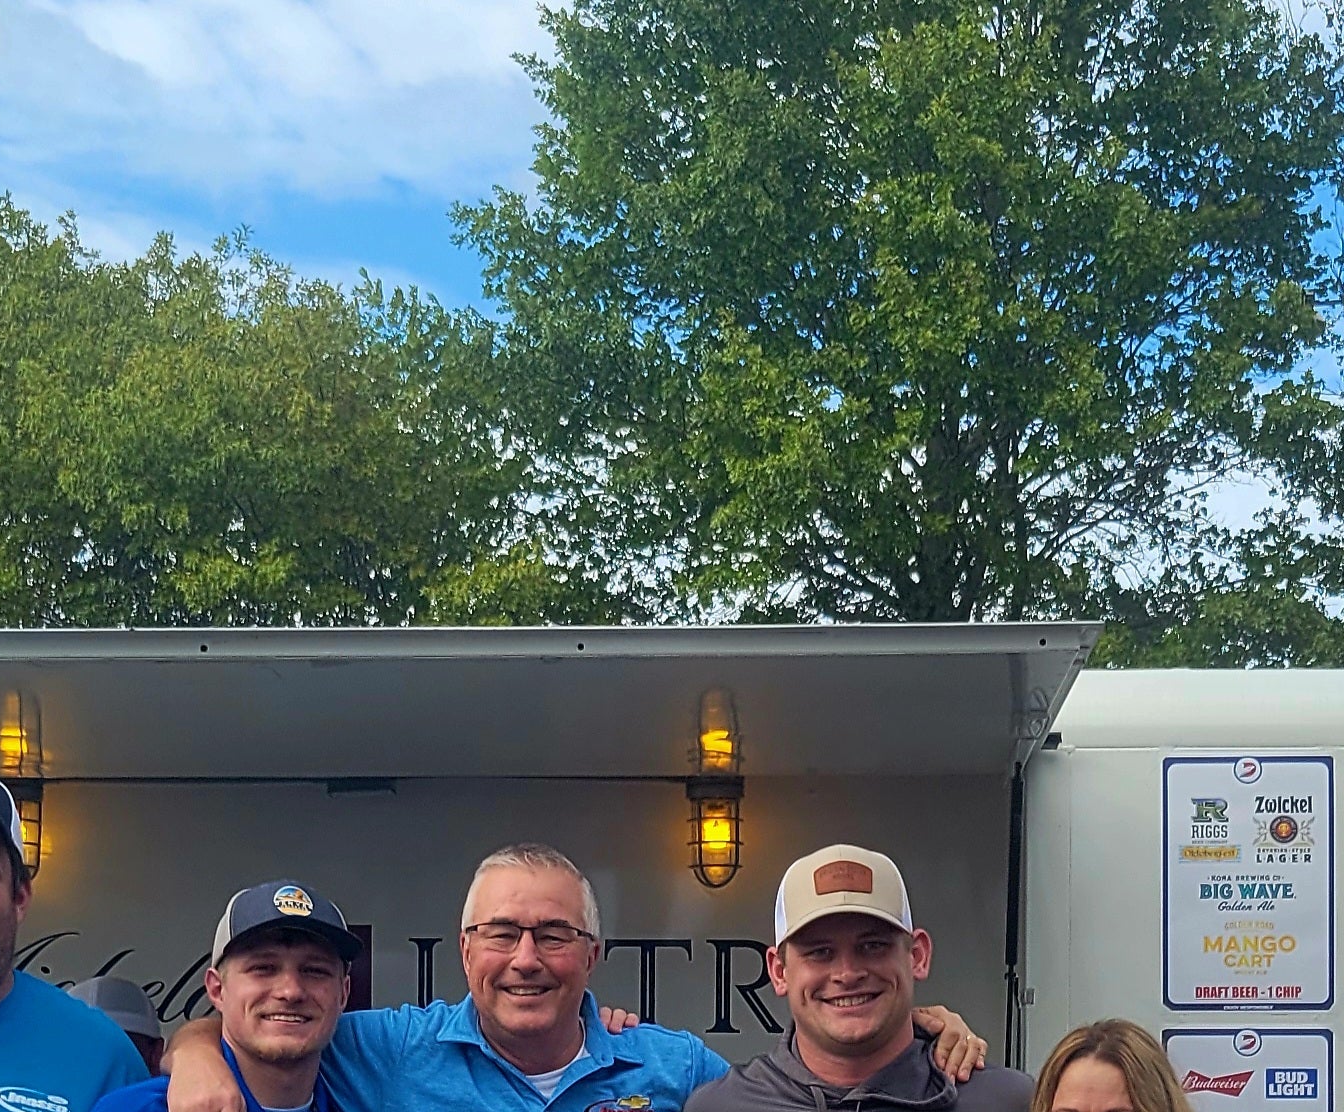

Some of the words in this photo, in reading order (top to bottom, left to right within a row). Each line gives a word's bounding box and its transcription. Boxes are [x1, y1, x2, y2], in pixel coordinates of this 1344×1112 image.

[1255, 796, 1312, 813] Zwickel
[1191, 825, 1228, 838] RIGGS
[1200, 884, 1233, 899] BIG
[1218, 901, 1252, 911] Golden
[1257, 901, 1275, 911] Ale
[1203, 936, 1296, 953] MANGO
[1224, 955, 1275, 968] CART
[1195, 986, 1229, 998] DRAFT
[1232, 986, 1258, 998] BEER
[1268, 987, 1273, 998] 1
[1275, 987, 1301, 998] CHIP
[1183, 1075, 1247, 1089] Budweiser
[1275, 1072, 1308, 1084] BUD
[1269, 1084, 1314, 1096] LIGHT
